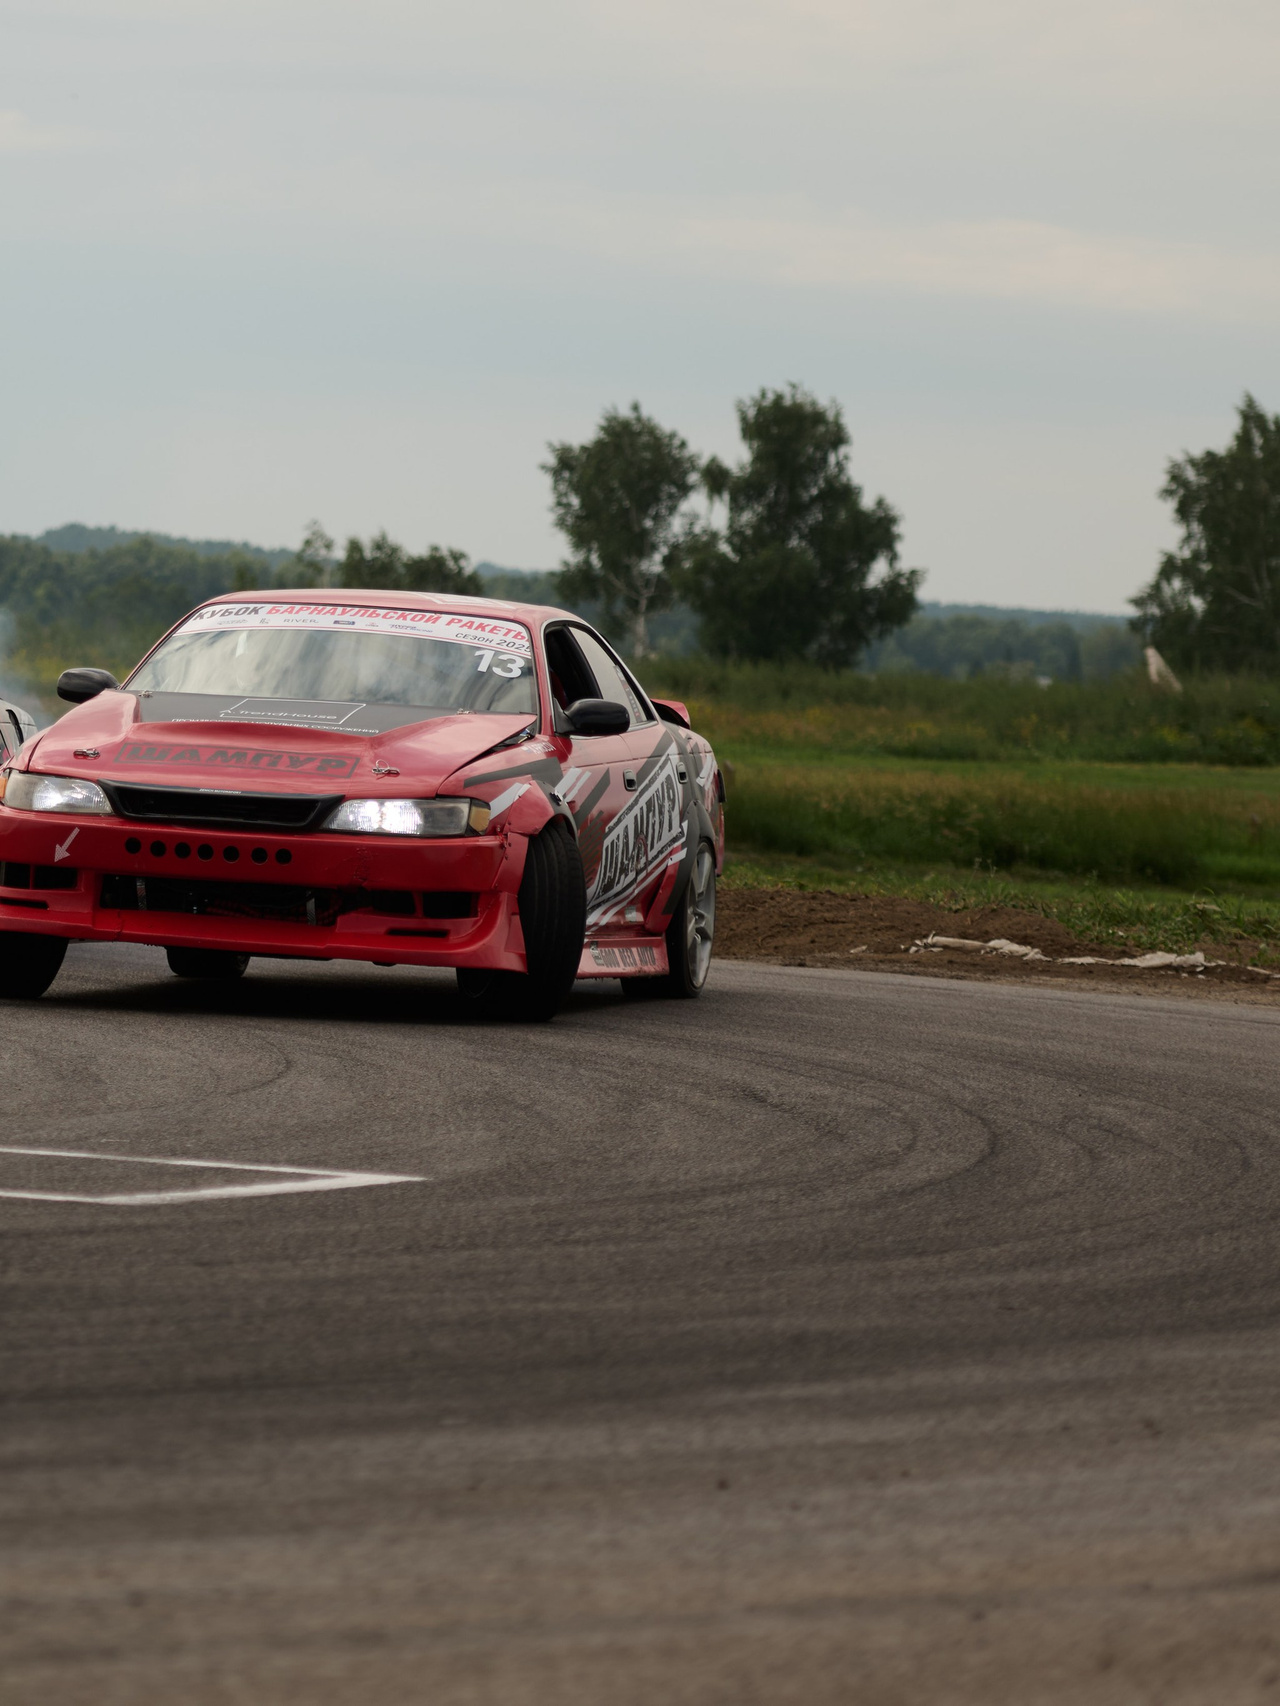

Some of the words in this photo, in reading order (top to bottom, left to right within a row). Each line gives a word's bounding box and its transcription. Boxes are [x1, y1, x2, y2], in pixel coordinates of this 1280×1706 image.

[193, 605, 266, 621] КУБОК
[266, 605, 444, 625] БАРНАУЛЬСКОЙ
[455, 632, 494, 644] СЕЗОН
[474, 649, 526, 679] 13
[123, 744, 349, 774] ШАМПУР
